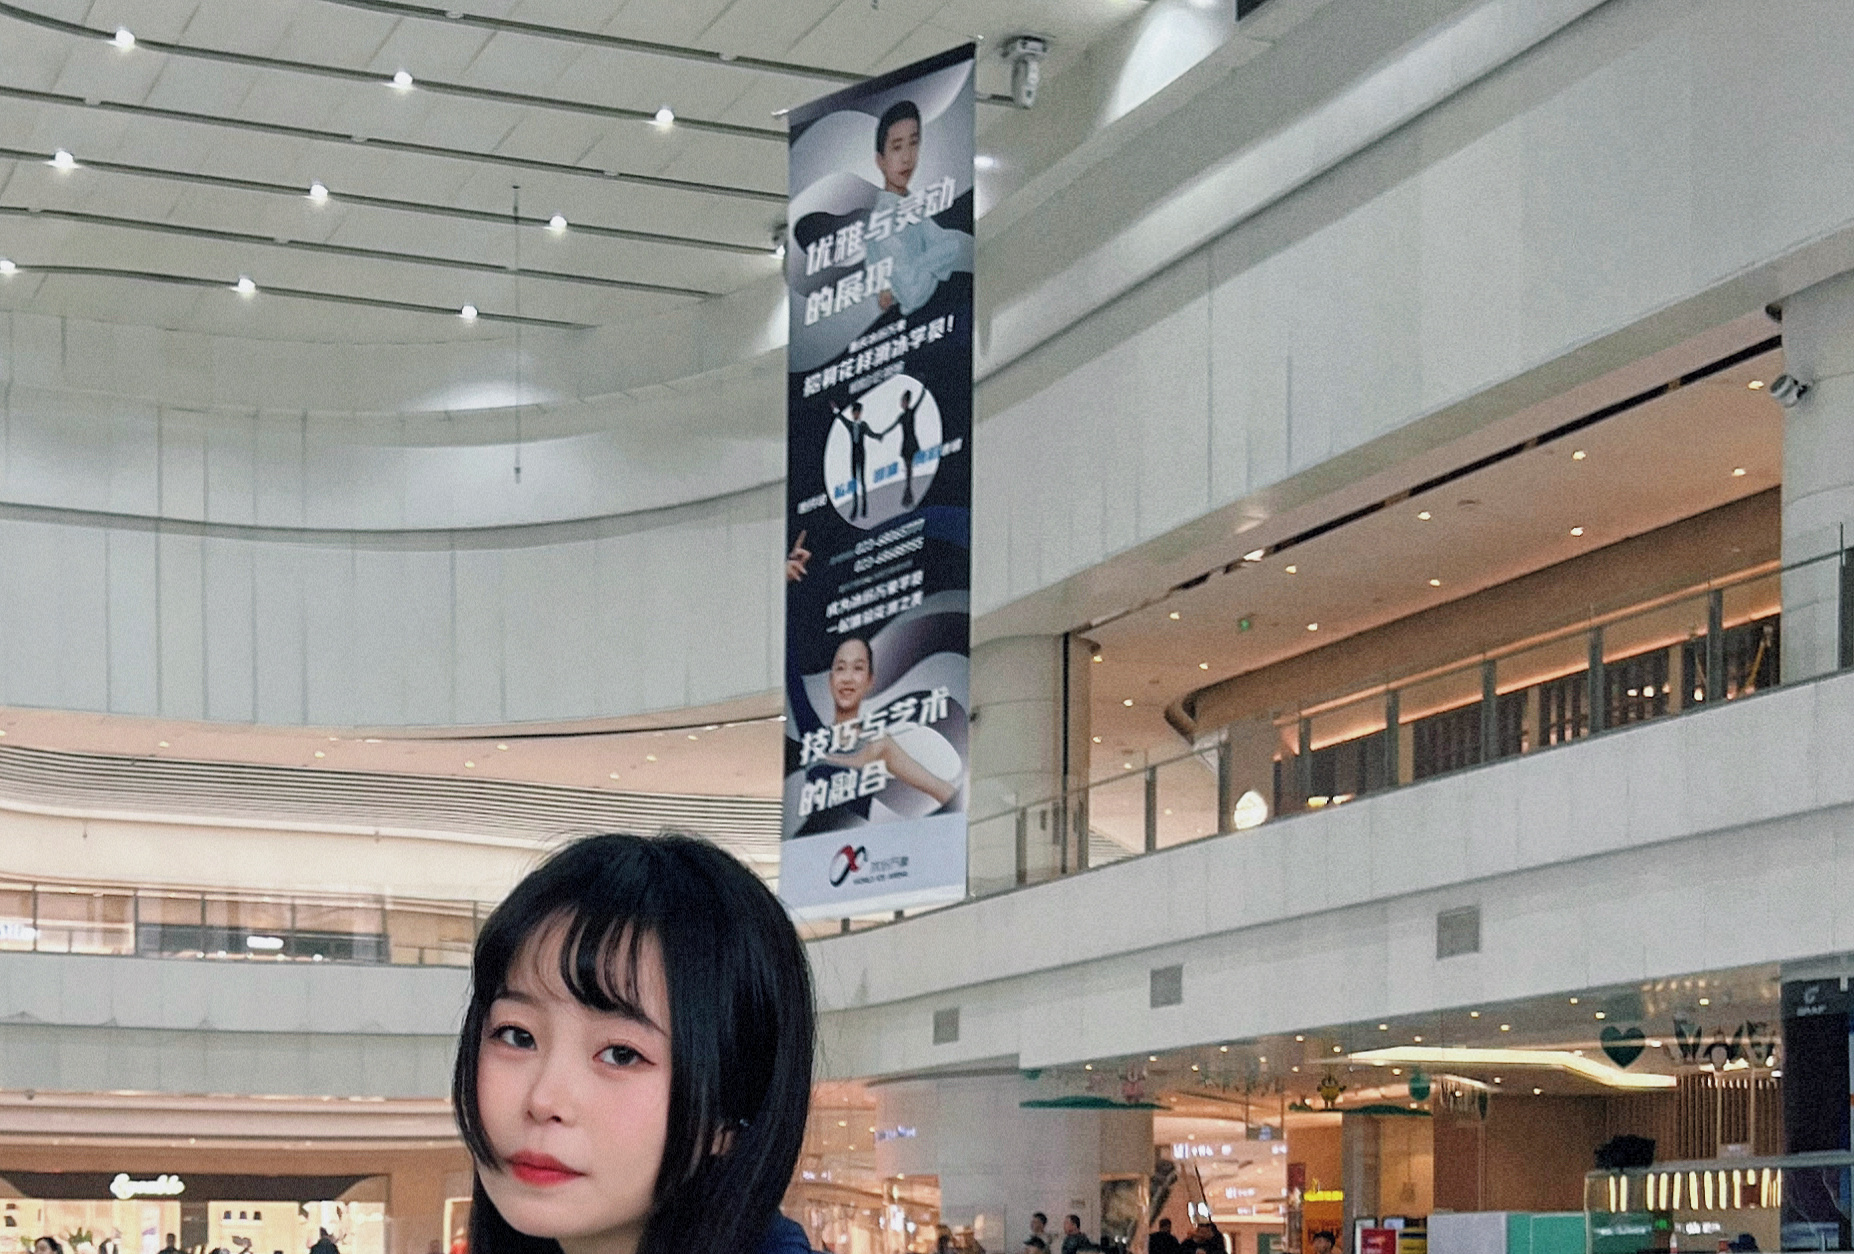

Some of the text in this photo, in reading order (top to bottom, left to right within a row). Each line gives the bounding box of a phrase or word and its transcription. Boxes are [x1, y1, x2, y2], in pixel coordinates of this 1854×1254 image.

[804, 176, 956, 276] 优雅与灵动
[804, 256, 894, 326] 的展现
[799, 685, 950, 766] 技巧与艺术
[798, 759, 896, 817] 的融合
